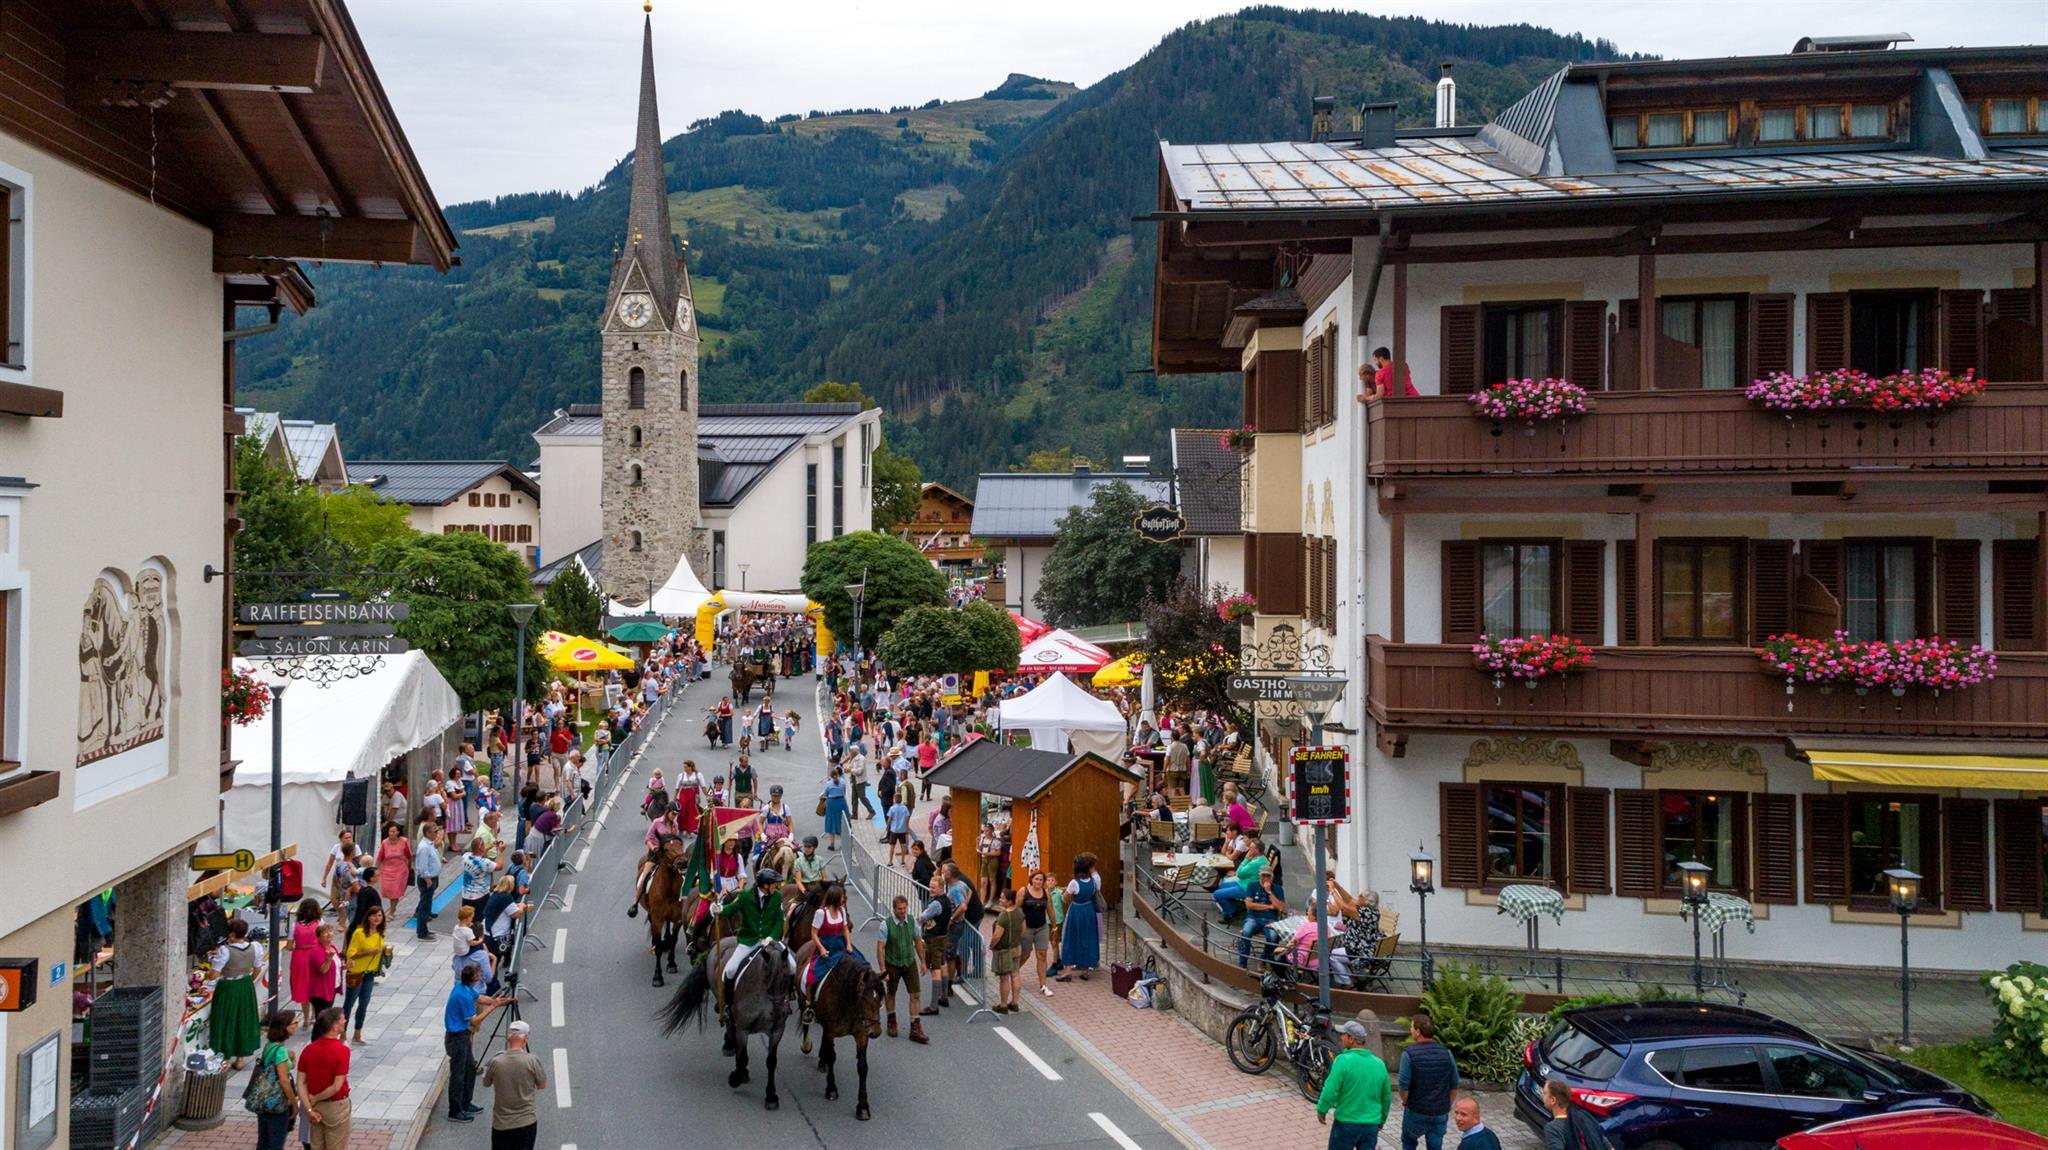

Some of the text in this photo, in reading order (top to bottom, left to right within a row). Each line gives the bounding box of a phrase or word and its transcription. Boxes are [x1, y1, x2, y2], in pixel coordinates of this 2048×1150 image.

[250, 603, 396, 621] RAIFFEISENBANK
[275, 640, 390, 654] SALON KARIN
[1259, 689, 1312, 699] ZIMMER
[1295, 750, 1344, 761] SIE FAHREN
[1311, 785, 1330, 794] km/h
[236, 853, 249, 868] H
[55, 966, 62, 979] 2
